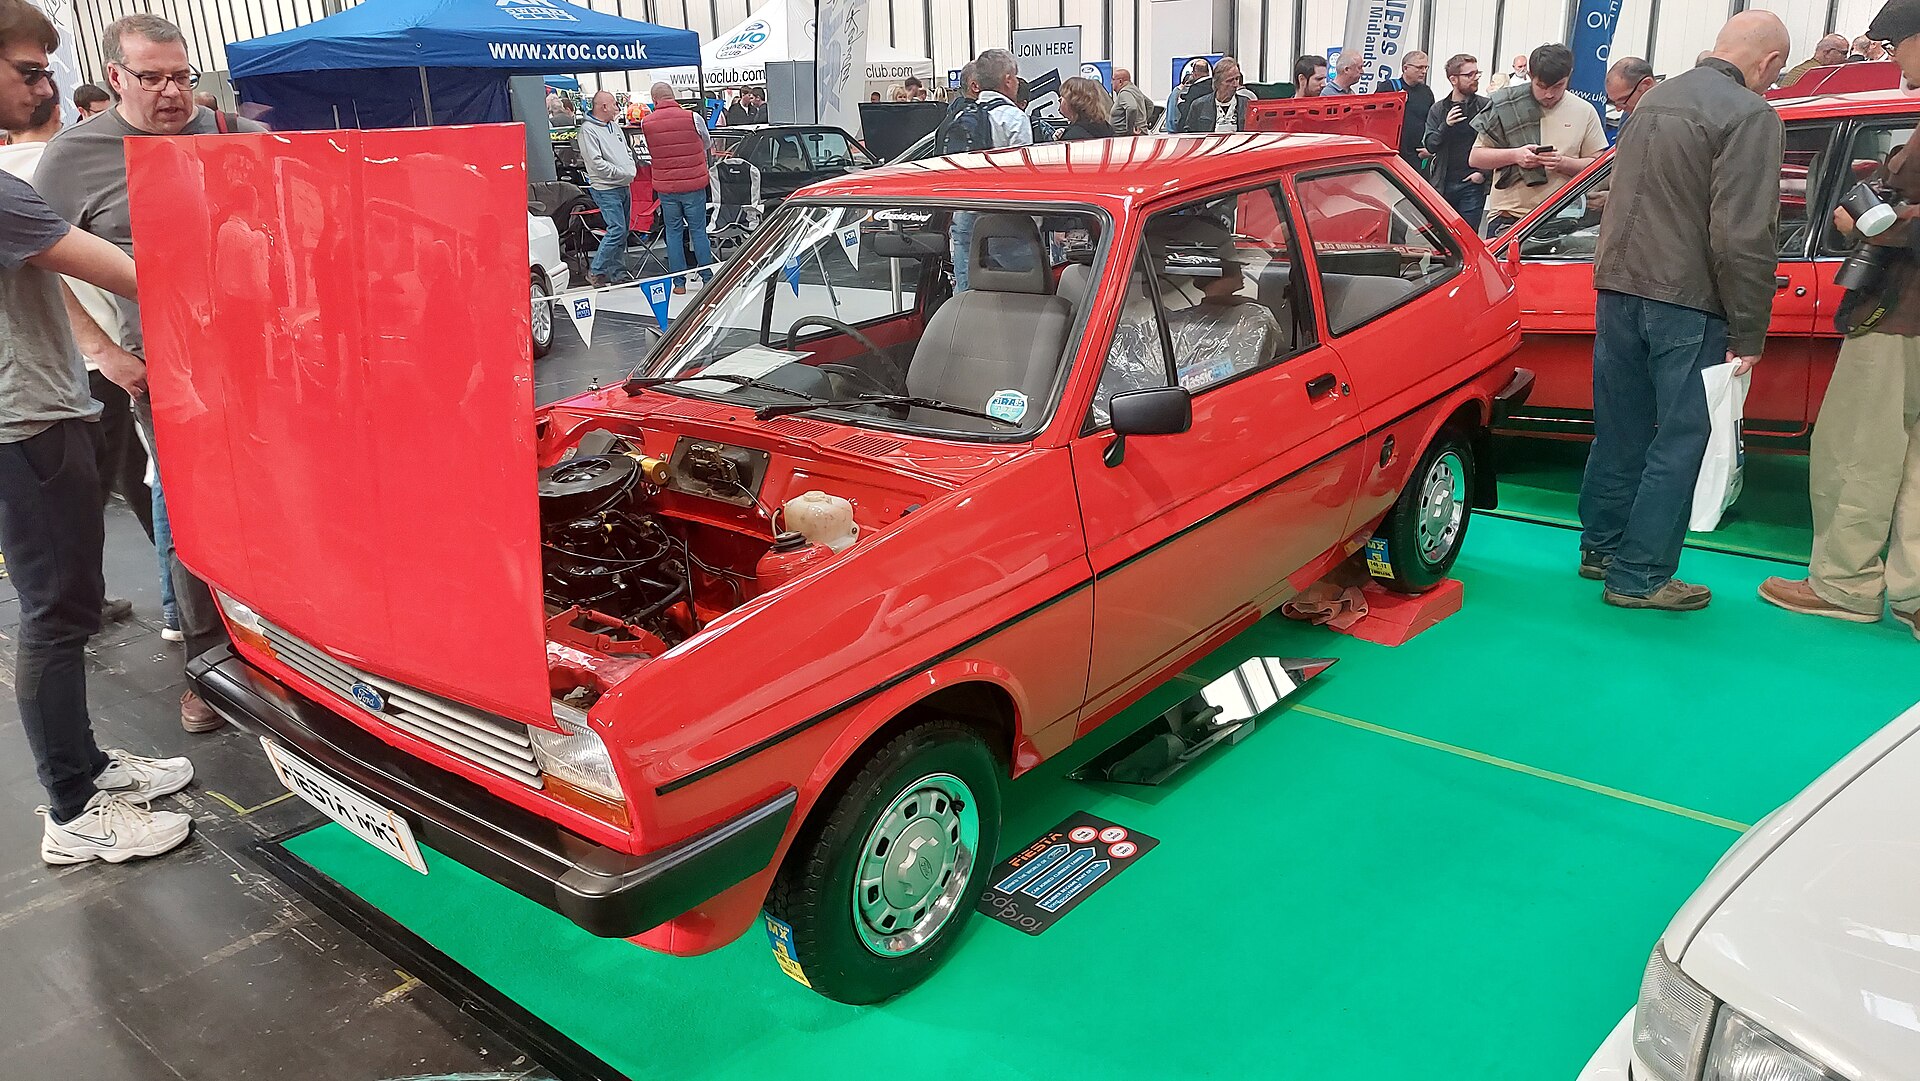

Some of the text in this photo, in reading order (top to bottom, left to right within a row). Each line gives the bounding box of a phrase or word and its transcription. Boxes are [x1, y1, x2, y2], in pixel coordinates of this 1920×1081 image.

[726, 31, 766, 47] AVO
[1363, 6, 1383, 68] Midlands
[488, 39, 648, 60] www.xroc.co.uk
[1018, 41, 1074, 58] JOIN HERE
[669, 67, 767, 85] www.voclub.com
[652, 286, 664, 296] XR
[575, 301, 590, 311] XR
[1008, 832, 1063, 868] FIESTA
